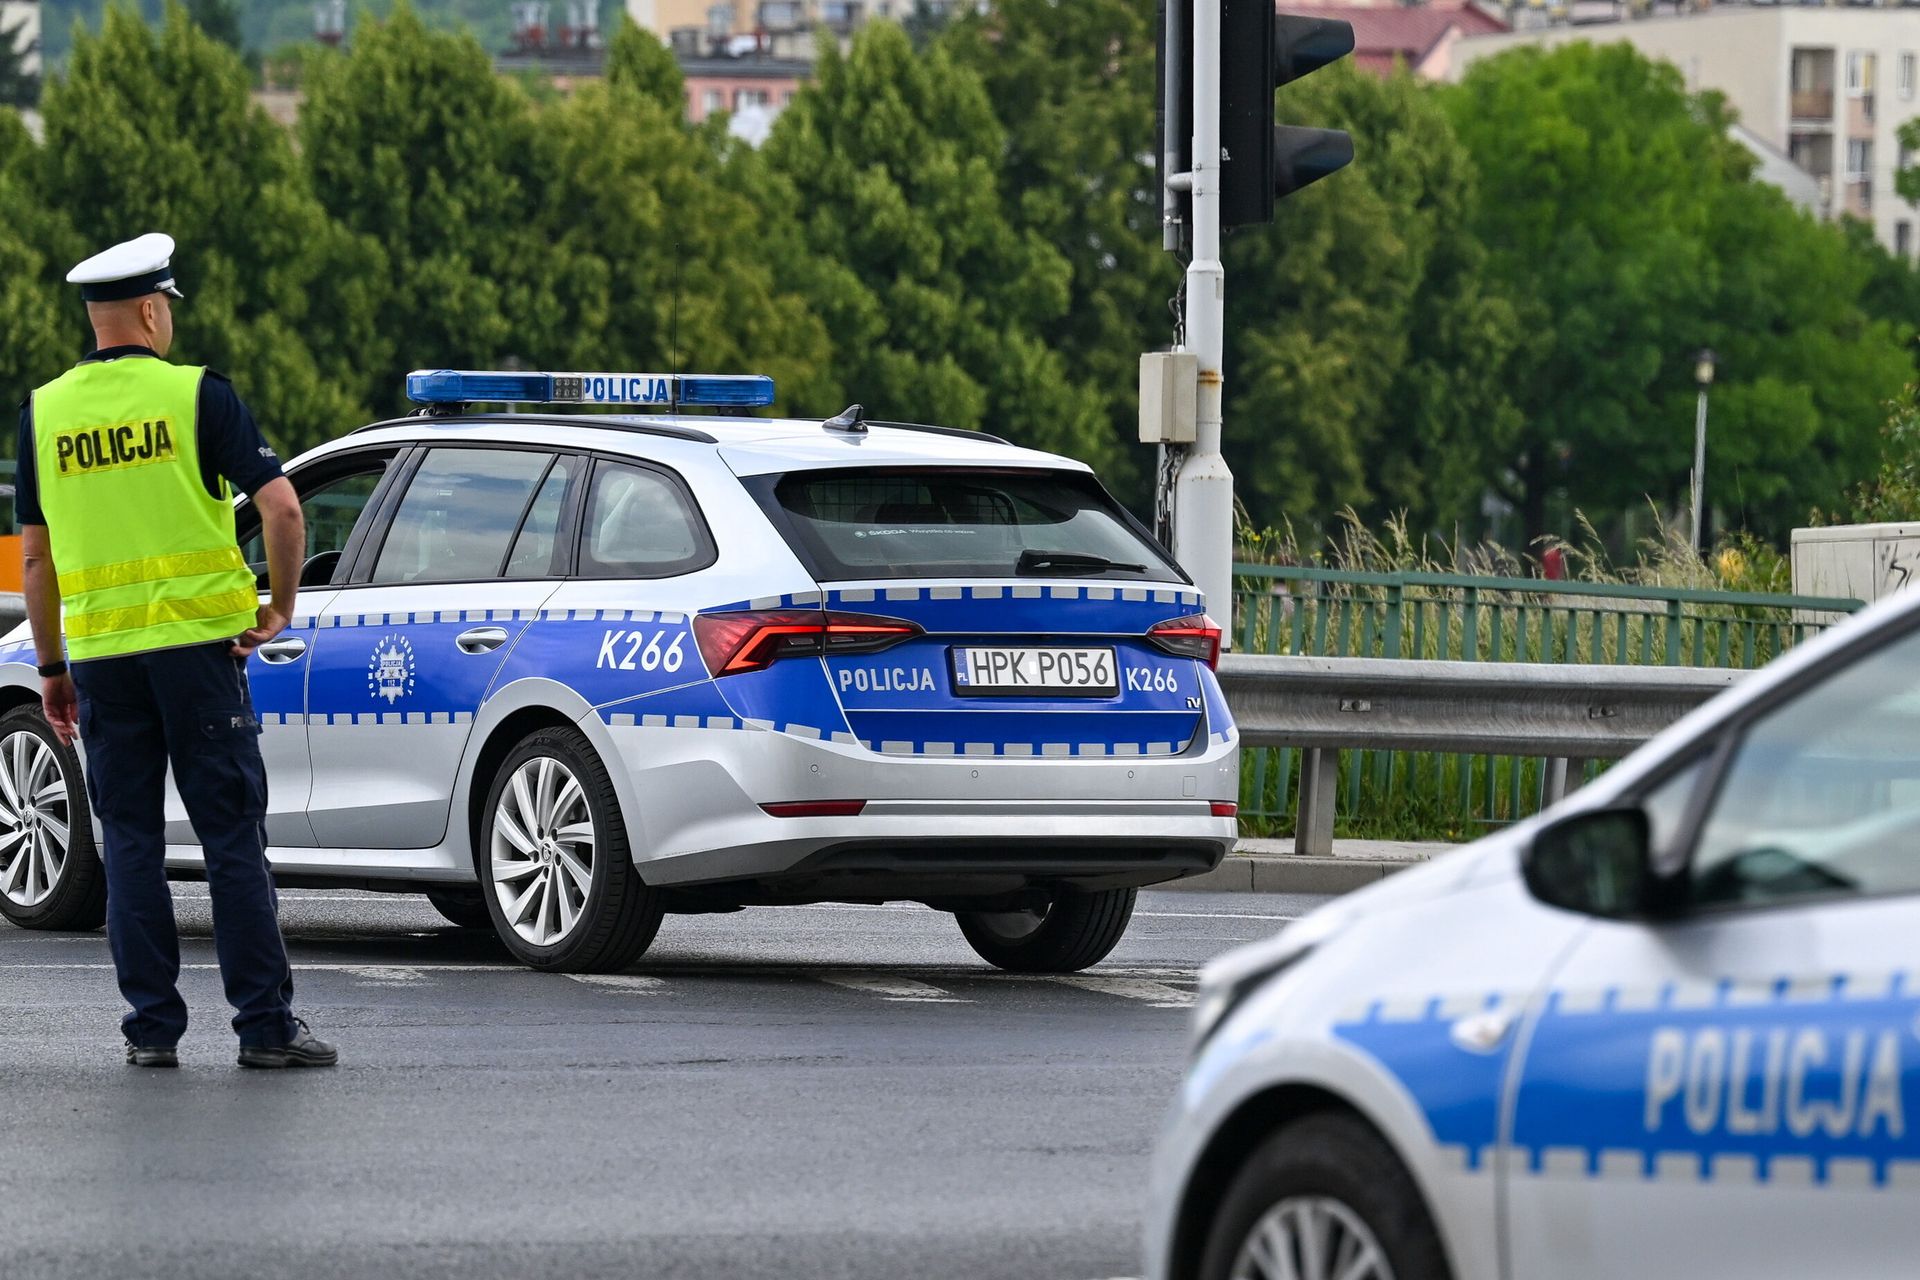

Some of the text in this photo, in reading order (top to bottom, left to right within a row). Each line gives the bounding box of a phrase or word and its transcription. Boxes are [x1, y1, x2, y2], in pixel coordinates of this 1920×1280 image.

[56, 420, 174, 473] POLICJA
[596, 629, 688, 673] K266
[972, 650, 1030, 685] HPK
[839, 667, 936, 693] POLICJA
[957, 672, 968, 682] PL
[1126, 667, 1178, 694] K266
[1643, 1026, 1905, 1139] POLICJA
